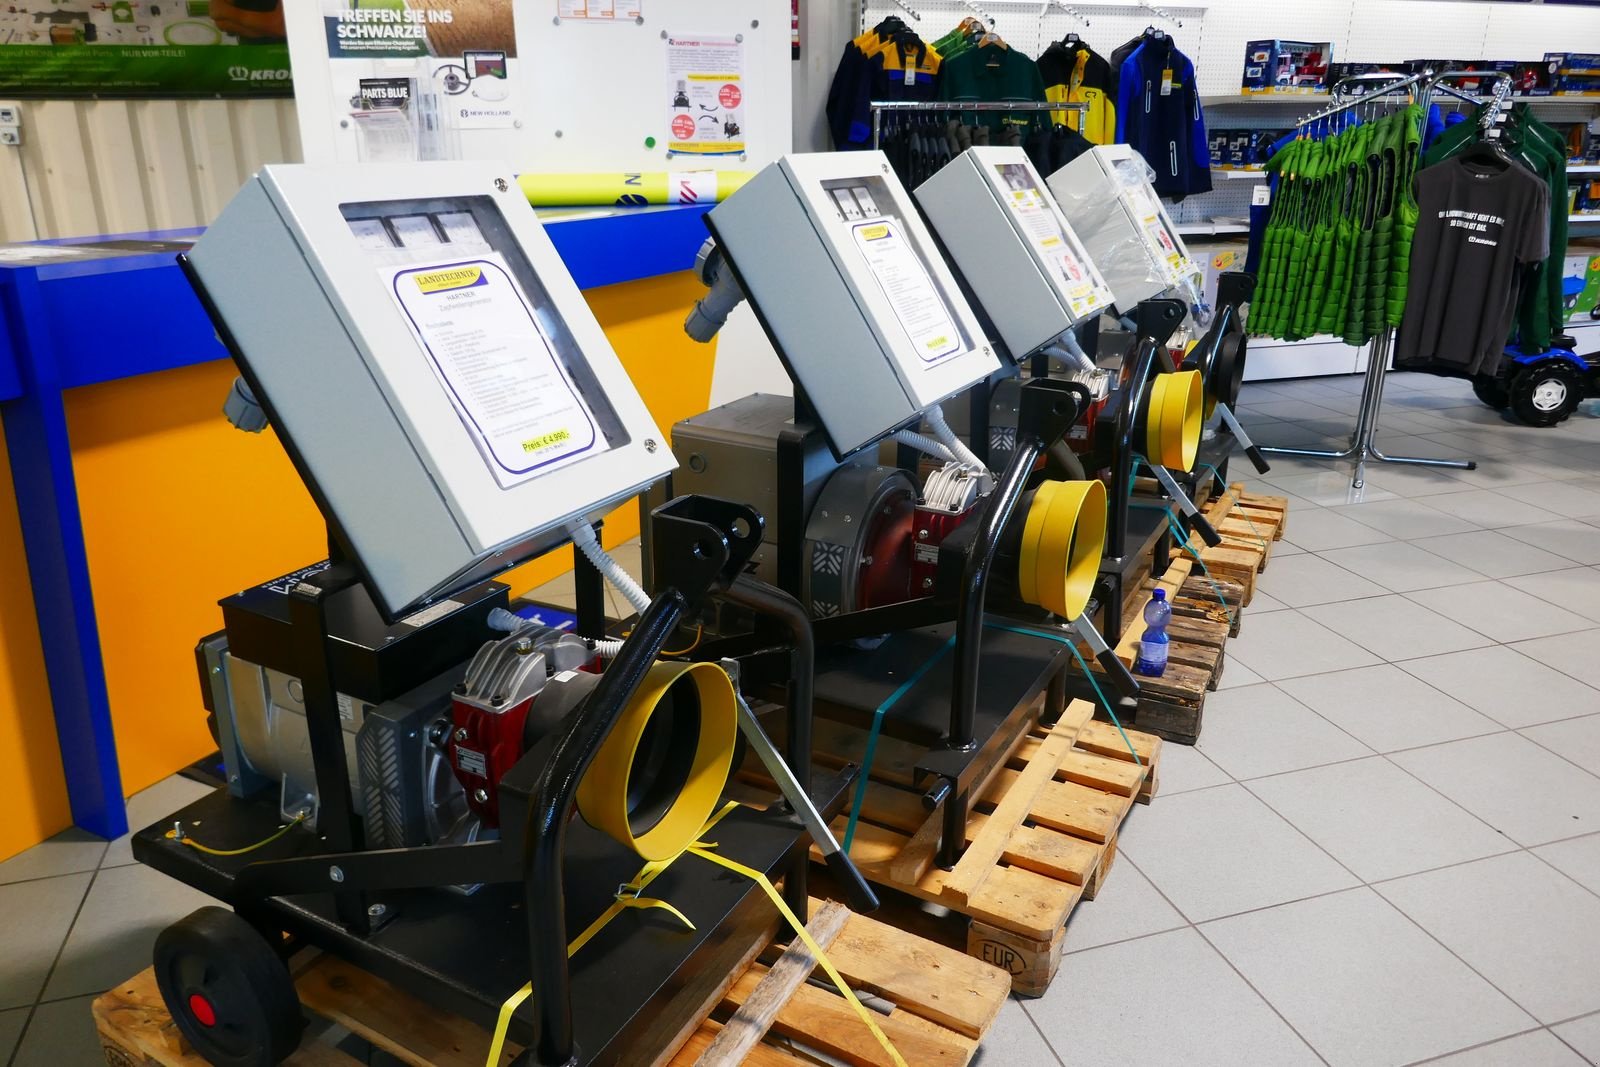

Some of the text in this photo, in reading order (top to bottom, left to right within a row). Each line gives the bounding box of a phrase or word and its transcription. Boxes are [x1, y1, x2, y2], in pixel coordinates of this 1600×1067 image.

[338, 9, 453, 24] TREFFEN SIE INS
[336, 24, 427, 39] SCHWARZE!
[250, 69, 293, 81] KRO
[361, 87, 409, 99] PARTS BLUE
[417, 269, 476, 286] LANDTECHNIK
[446, 291, 477, 301] HARTNER
[522, 440, 543, 452] Preis:
[982, 943, 1016, 971] EUR
